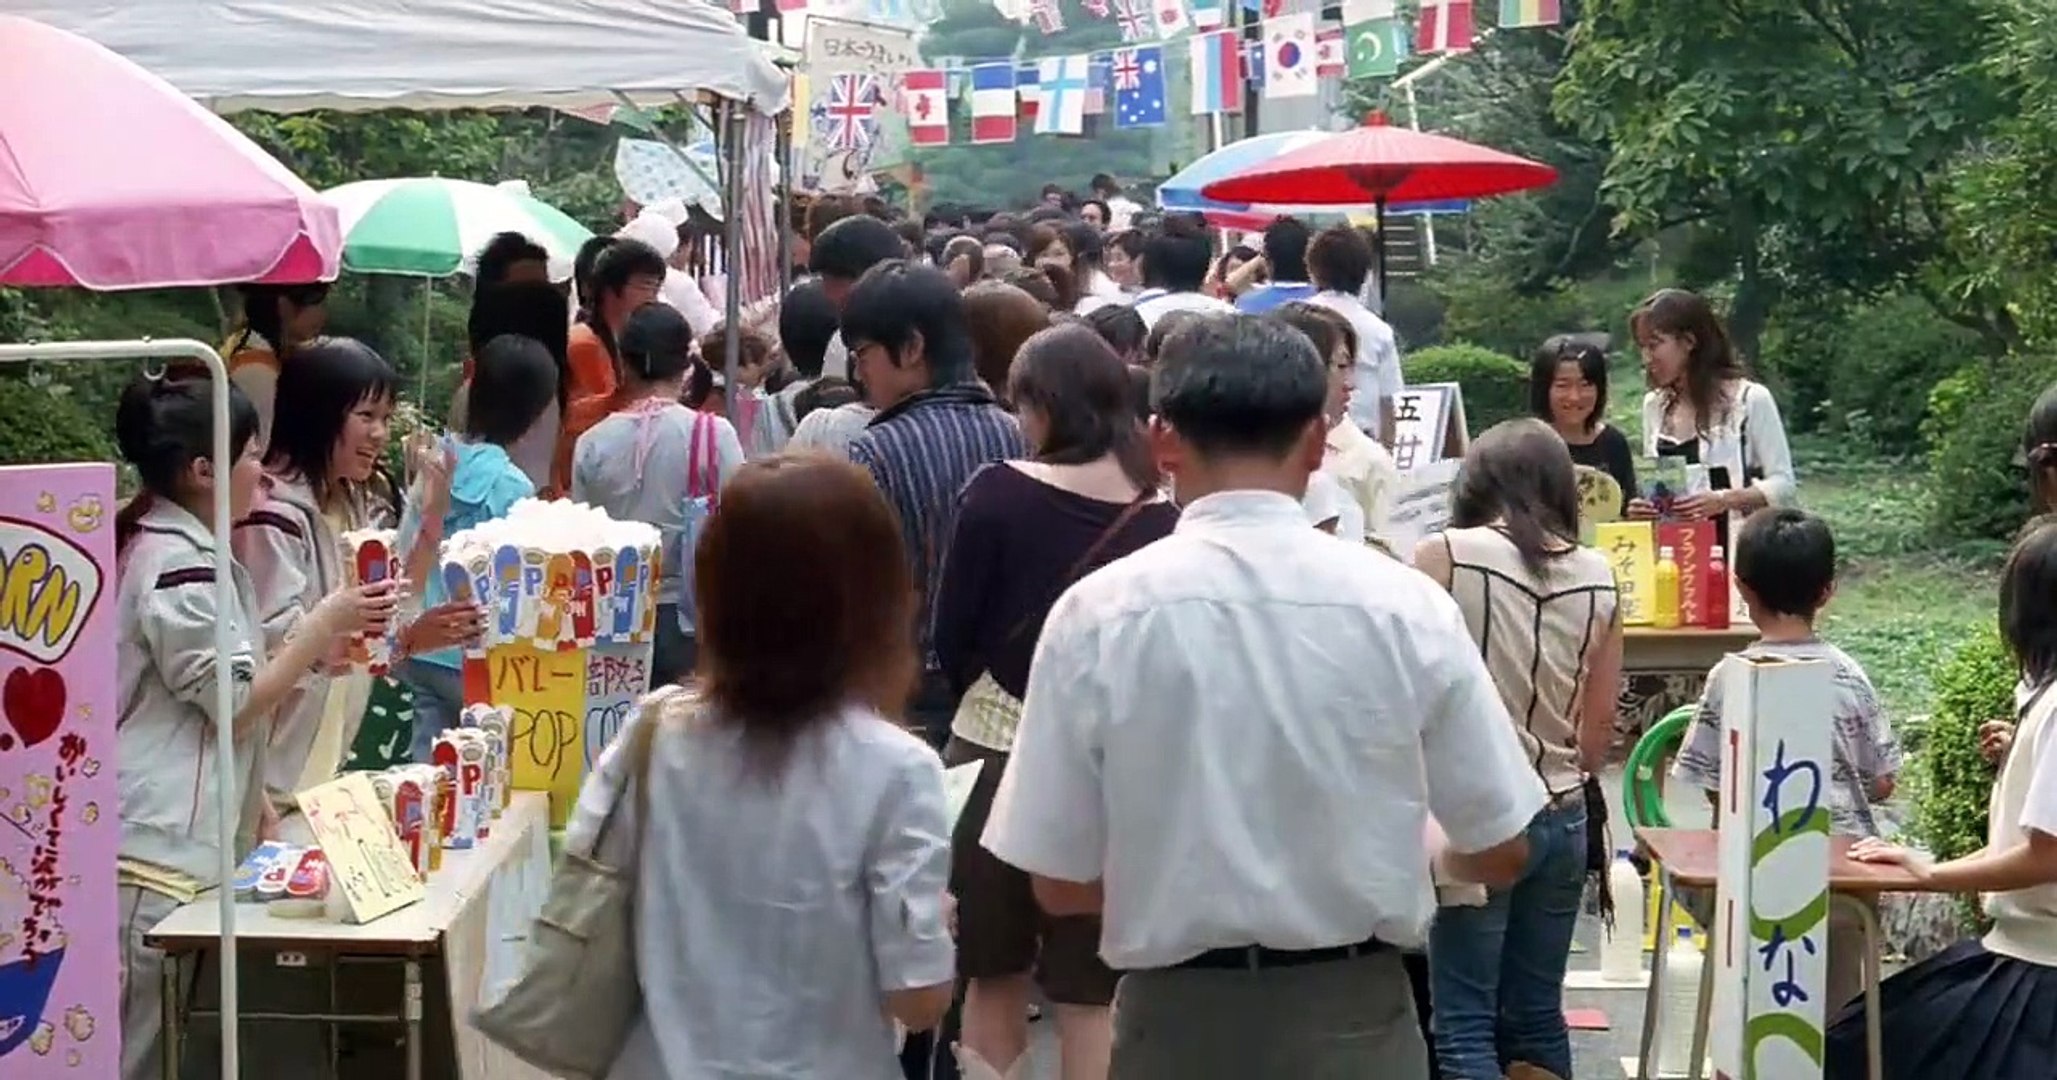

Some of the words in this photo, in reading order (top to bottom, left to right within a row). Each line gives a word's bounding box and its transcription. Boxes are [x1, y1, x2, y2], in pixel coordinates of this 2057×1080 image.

[1395, 395, 1421, 422] 五
[0, 542, 80, 648] RN
[1679, 528, 1697, 623] フランクフルト
[496, 655, 574, 693] バレー
[511, 707, 577, 781] POP
